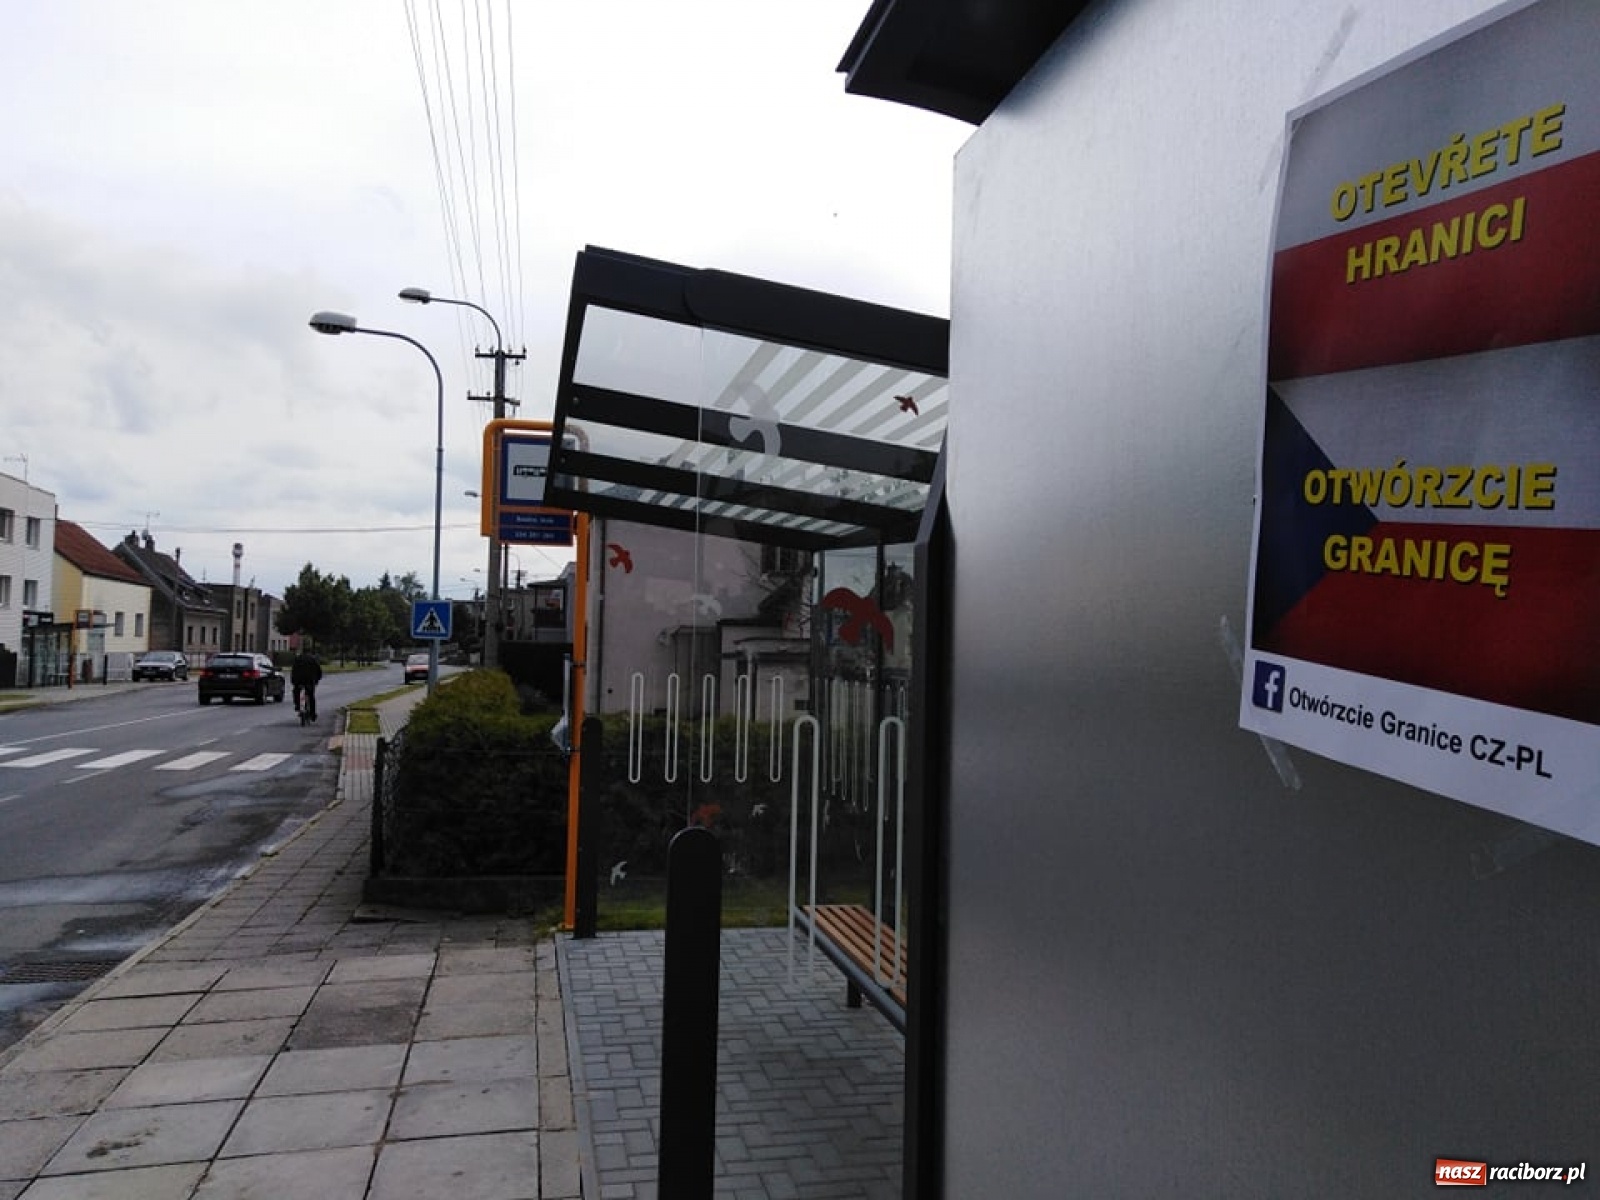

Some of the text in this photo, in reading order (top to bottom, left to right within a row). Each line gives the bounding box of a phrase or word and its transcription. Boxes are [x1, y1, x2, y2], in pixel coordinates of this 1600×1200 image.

[1345, 197, 1526, 284] HRANICI
[1303, 460, 1557, 511] OTWÓRZCIE
[1323, 534, 1511, 598] GRANICĘ
[1289, 687, 1553, 779] Otwórzcie Granice CZ-PL
